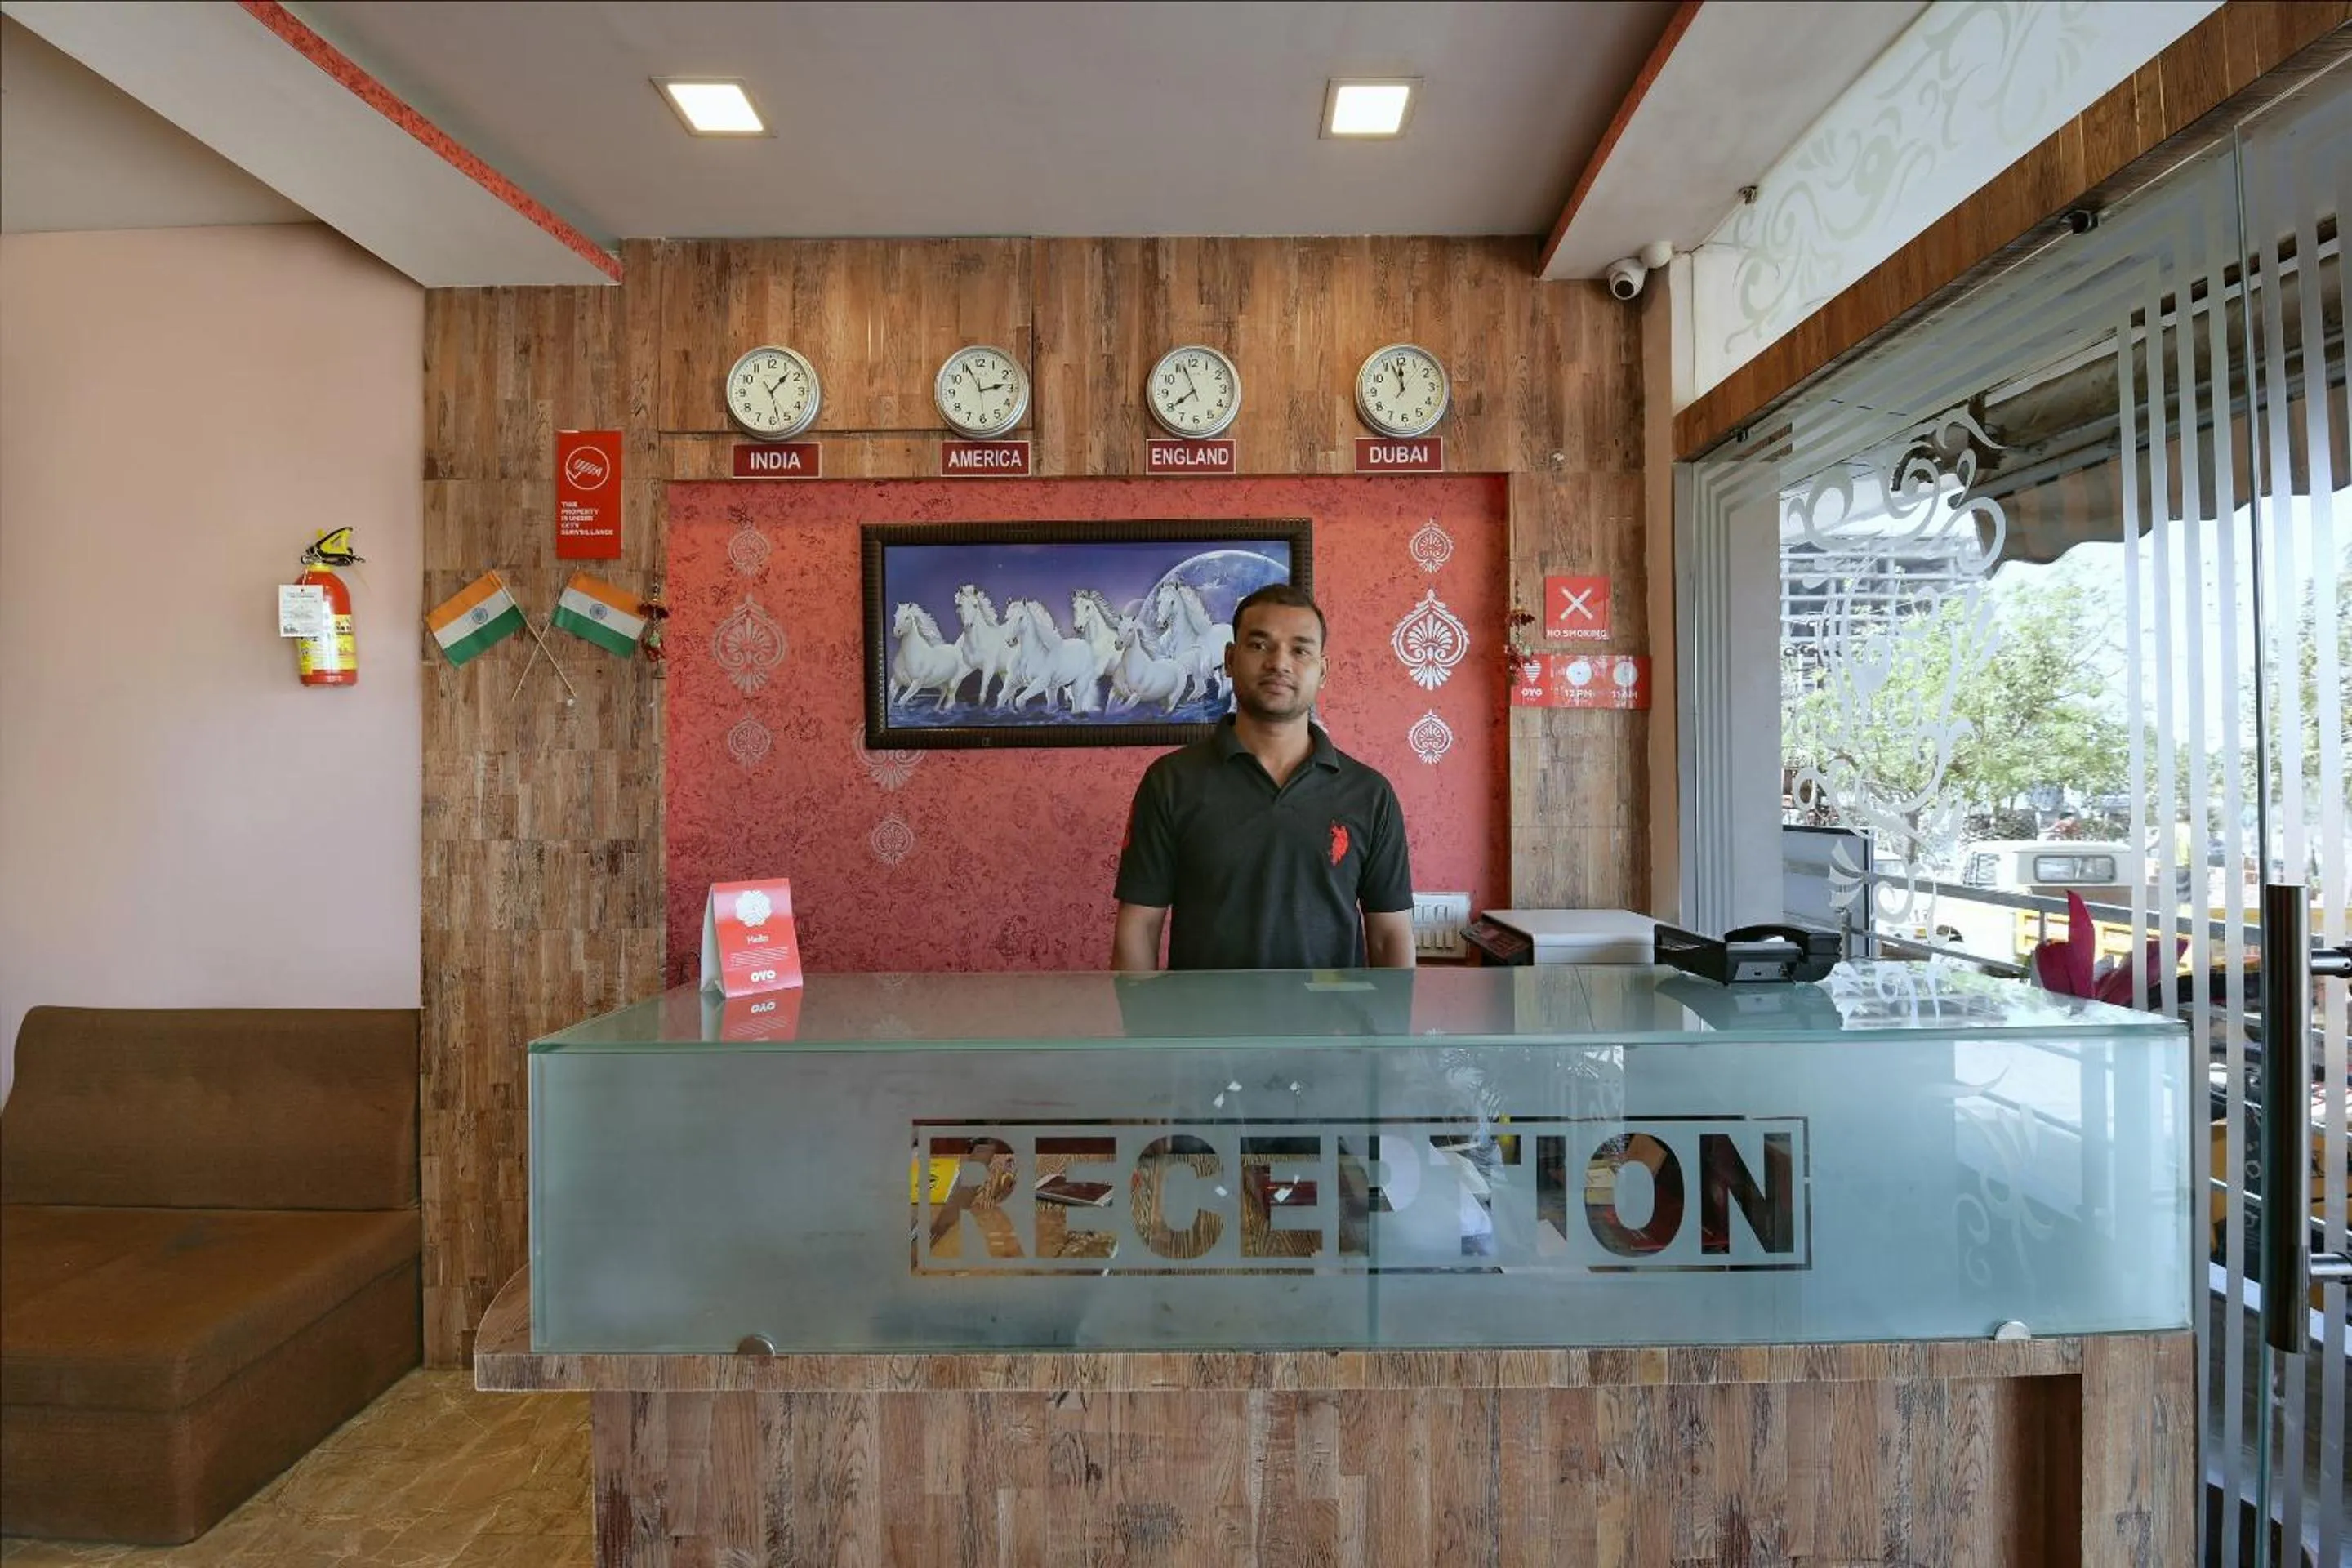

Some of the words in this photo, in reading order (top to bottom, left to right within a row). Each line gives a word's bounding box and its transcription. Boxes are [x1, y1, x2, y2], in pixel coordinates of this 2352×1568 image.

[750, 452, 801, 470] INDIA
[948, 449, 1022, 467] AMERICA
[1152, 448, 1229, 466] ENGLAND
[1369, 446, 1428, 464] DUBAI
[1547, 629, 1561, 638] NO
[1521, 688, 1543, 697] OYO
[751, 969, 776, 982] OYO
[929, 1132, 1795, 1260] RECEPTION
